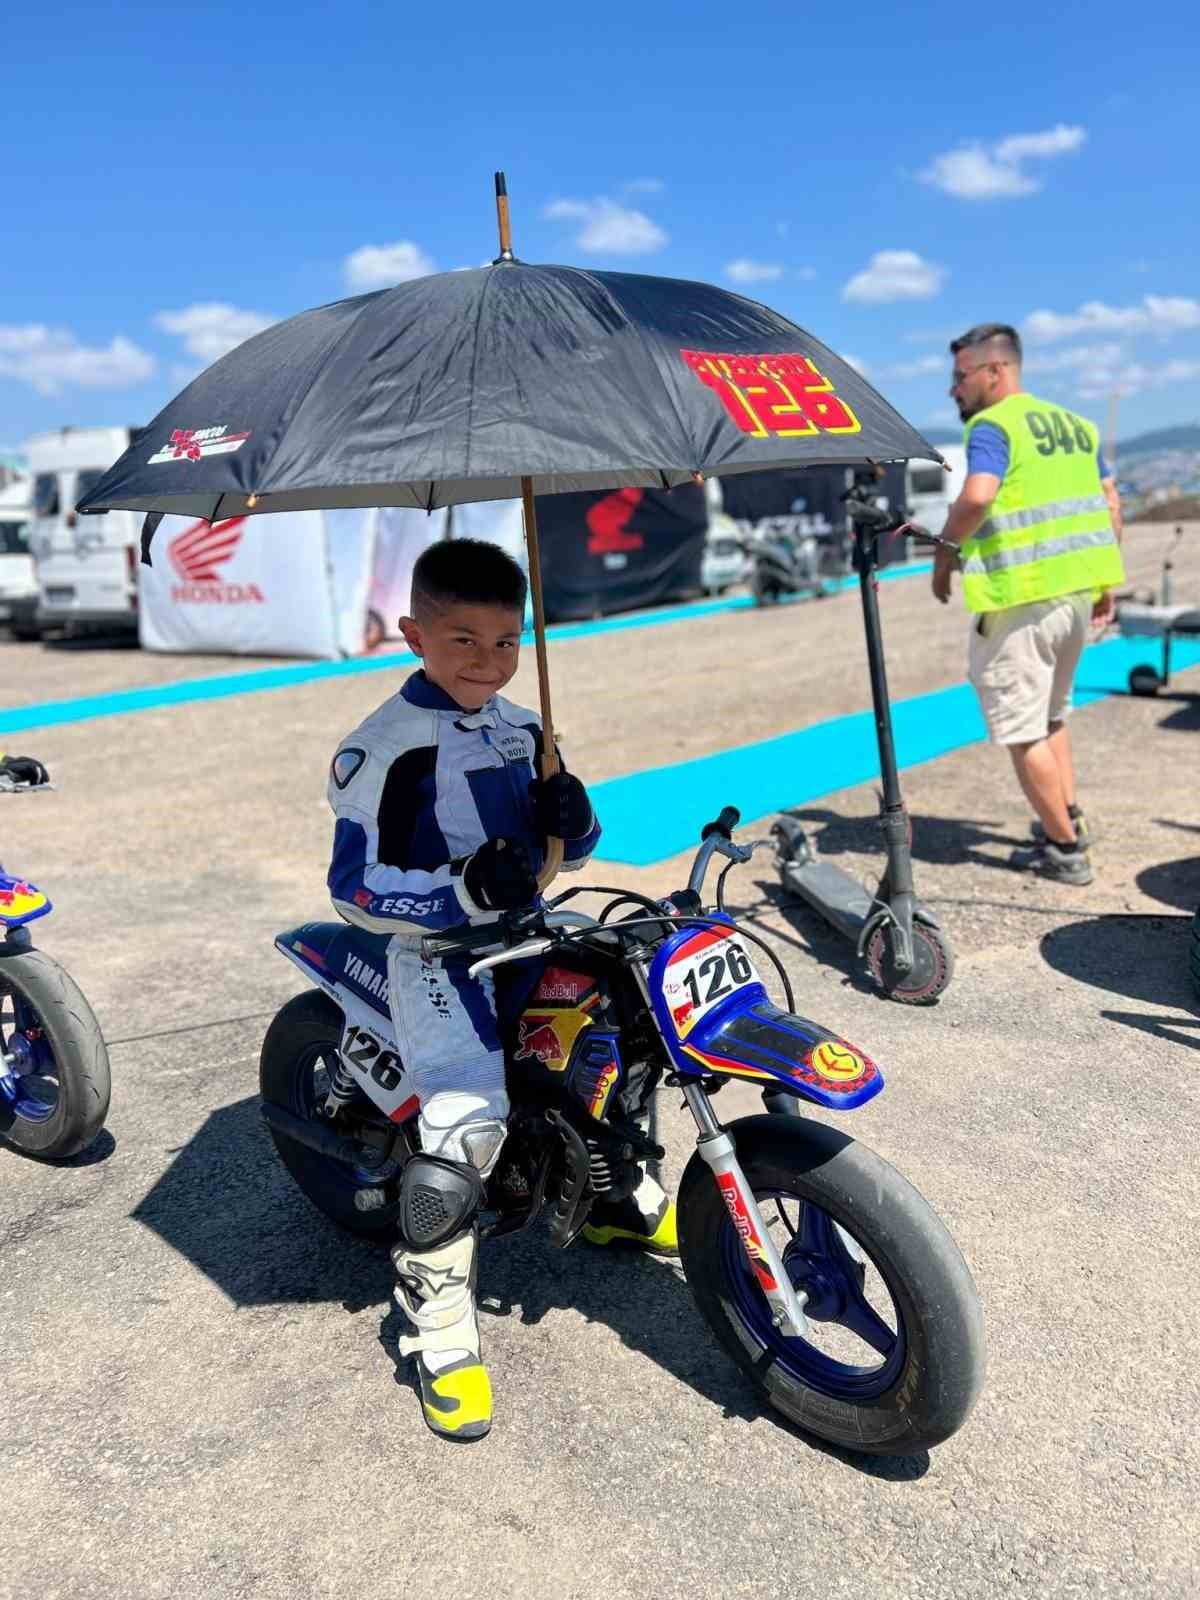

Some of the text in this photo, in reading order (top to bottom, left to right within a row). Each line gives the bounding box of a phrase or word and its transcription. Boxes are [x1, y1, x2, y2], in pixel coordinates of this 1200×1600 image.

[713, 368, 862, 437] 126
[170, 582, 264, 604] HONDA
[343, 951, 390, 1005] YAMAH
[683, 943, 752, 1009] 126
[342, 1025, 406, 1092] 126
